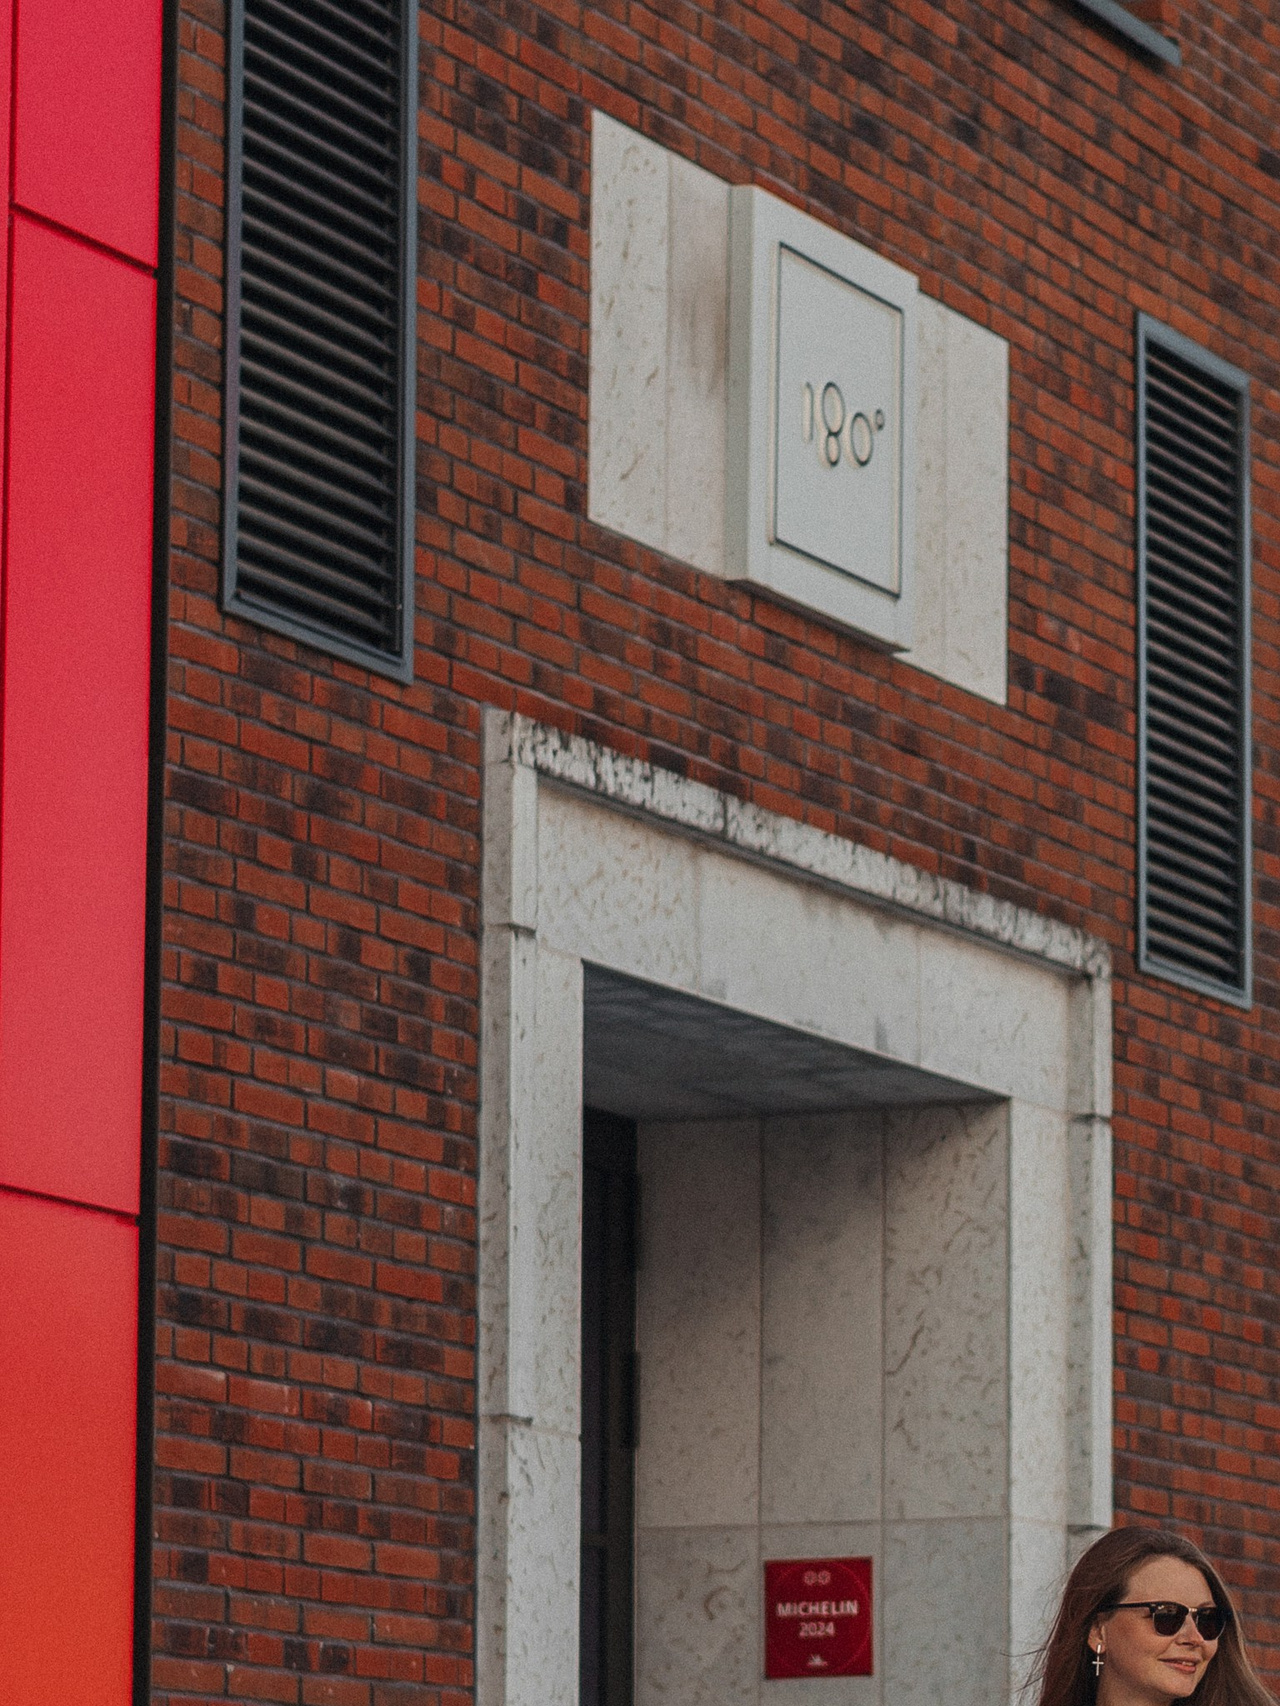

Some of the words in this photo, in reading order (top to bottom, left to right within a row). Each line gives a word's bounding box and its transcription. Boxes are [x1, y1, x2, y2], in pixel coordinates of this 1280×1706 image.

[803, 381, 885, 467] 180°
[776, 1600, 858, 1616] MICHELIN
[799, 1622, 836, 1637] 2024
